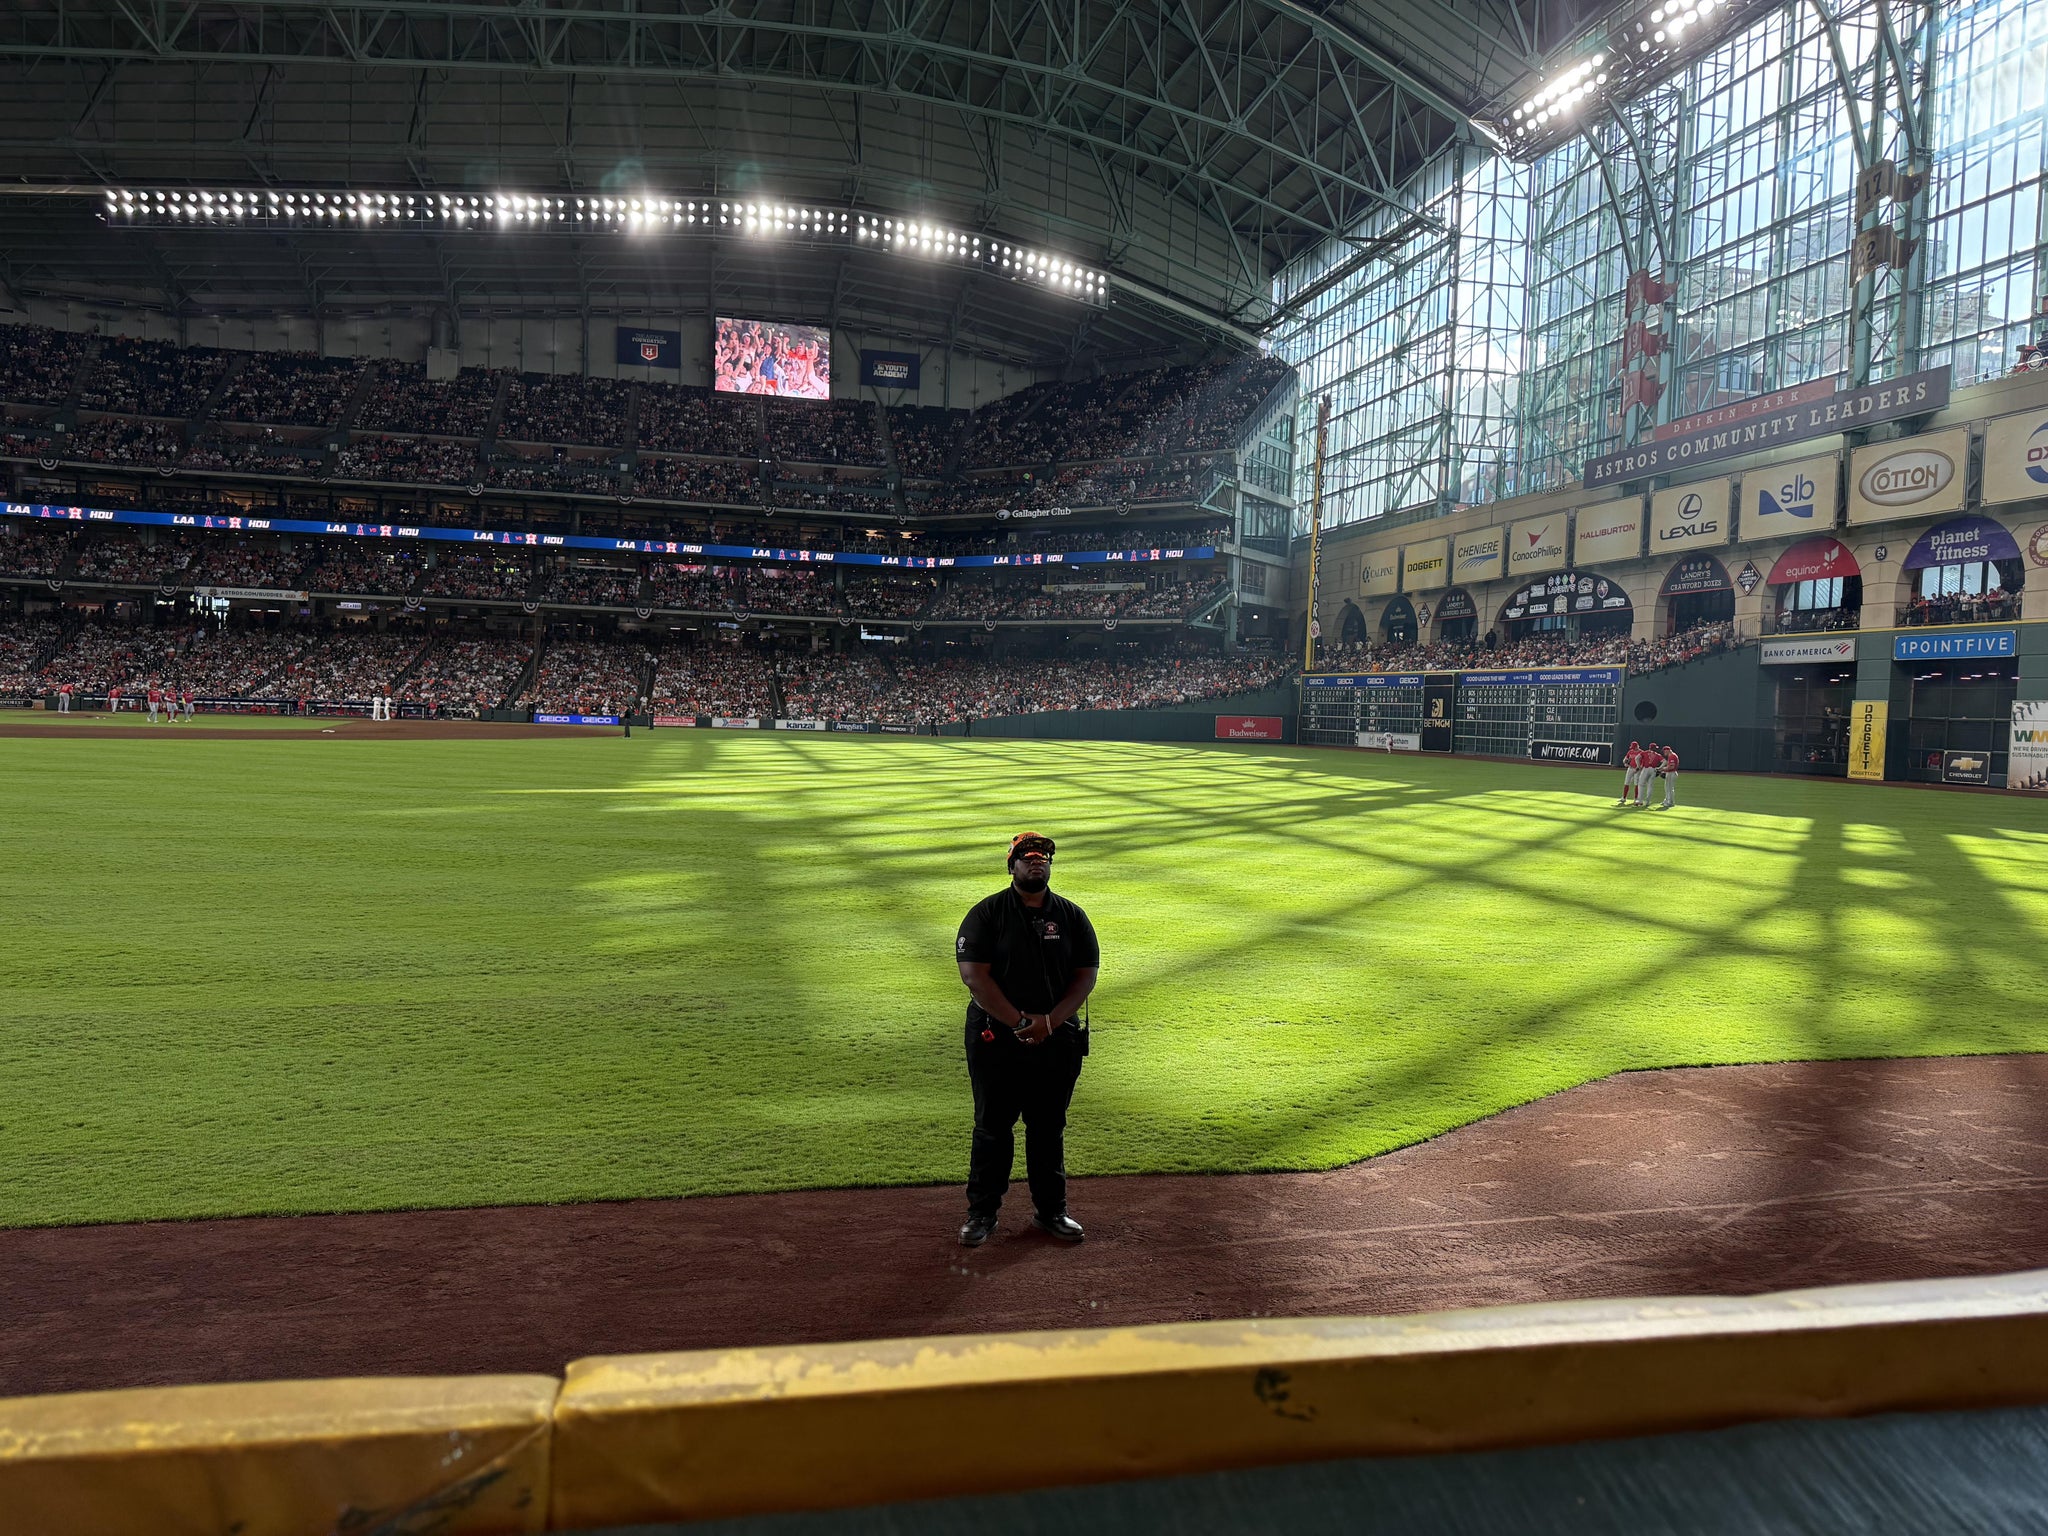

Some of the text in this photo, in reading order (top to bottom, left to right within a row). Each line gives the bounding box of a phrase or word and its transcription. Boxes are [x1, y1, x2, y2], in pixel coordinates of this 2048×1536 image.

[1864, 171, 1882, 202] 17
[873, 370, 908, 378] ACADEMY
[885, 364, 908, 372] YOUTH
[1673, 390, 1801, 433] DAIKIN PARK
[1594, 381, 1928, 479] ASTROS COMMUNITY LEADERS
[1871, 464, 1939, 495] COTTON
[1780, 474, 1815, 503] slb
[6, 504, 31, 514] LAA
[90, 510, 114, 520] HOU
[1012, 507, 1071, 518] Gallagher Club
[173, 516, 195, 525] LAA
[248, 519, 270, 529] HOU
[326, 524, 347, 533] LAA
[398, 528, 419, 537] HOU
[1579, 523, 1636, 540] HALLIBURTON
[1659, 520, 1718, 541] LEXUS
[473, 532, 494, 541] LAA
[543, 536, 564, 545] HOU
[1930, 527, 1979, 550] planet
[616, 540, 636, 549] LAA
[683, 544, 703, 553] HOU
[1457, 540, 1499, 558] CHENIERE
[1876, 548, 1886, 556] 24
[1935, 543, 1989, 561] fitness
[752, 549, 771, 558] LAA
[815, 552, 834, 561] HOU
[993, 556, 1009, 565] LAA
[1046, 554, 1063, 563] HOU
[1106, 552, 1123, 560] LAA
[1165, 549, 1184, 559] HOU
[1512, 545, 1562, 563] ConocoPhillips
[881, 556, 899, 565] LAA
[939, 558, 955, 567] HOU
[1407, 559, 1443, 572] DOGGETT
[1370, 567, 1393, 578] CALPINE
[1680, 570, 1711, 580] LANDRY'S
[1785, 564, 1821, 578] equinor
[1312, 556, 1321, 618] FAIR
[1671, 579, 1722, 591] CRAWFORD BOXES
[220, 590, 283, 598] ASTROS.COM/BUDDIES
[1796, 647, 1832, 656] AMERICA
[1900, 637, 2008, 654] 1POINTFIVE
[1424, 719, 1450, 727] BETMGM
[1527, 690, 1537, 757] AMERICAN
[1229, 729, 1268, 737] Budweiser
[1862, 704, 1873, 770] DOGGETT
[2014, 730, 2048, 742] WM
[1541, 744, 1599, 761] NITTOTIRE.COM
